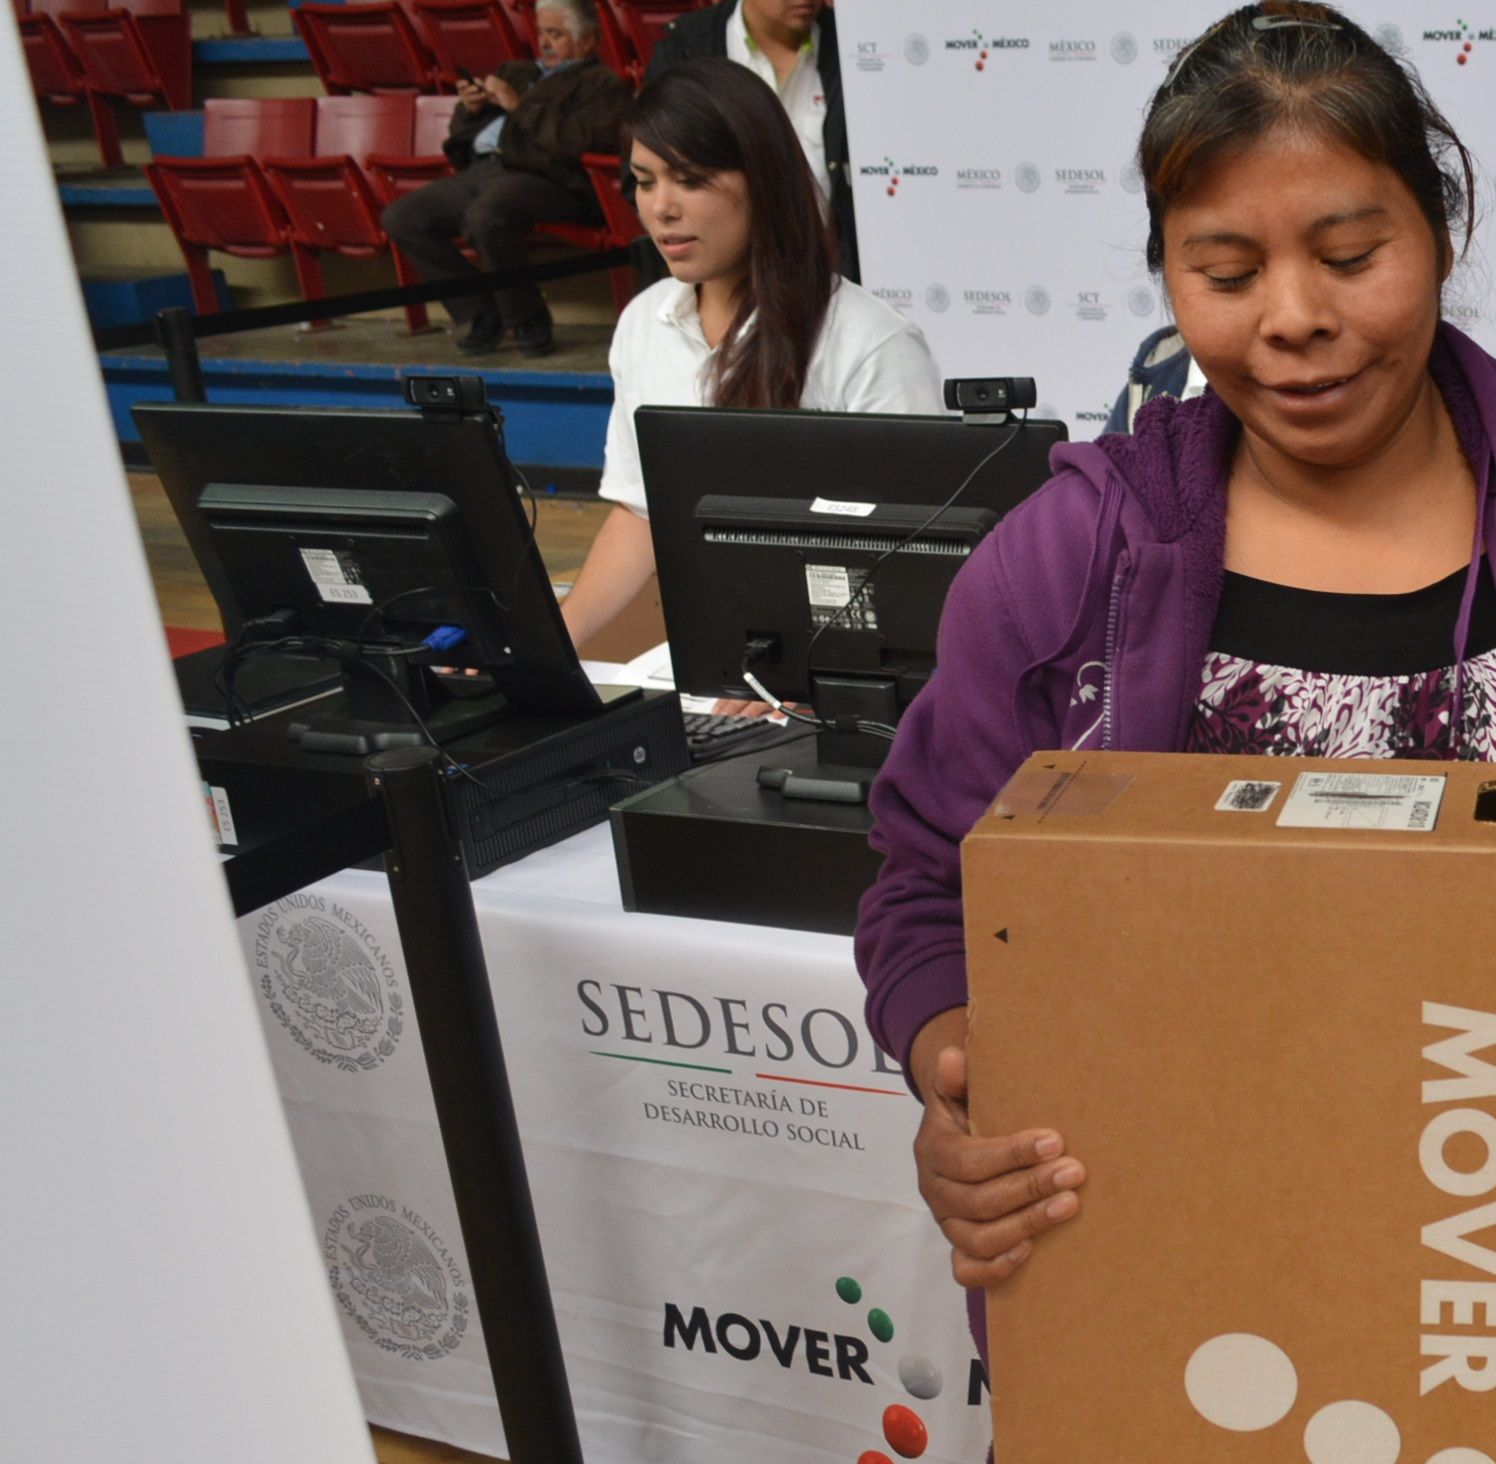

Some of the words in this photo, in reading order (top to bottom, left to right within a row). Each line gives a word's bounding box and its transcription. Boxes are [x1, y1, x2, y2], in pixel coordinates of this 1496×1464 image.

[945, 39, 978, 49] MOVER
[992, 36, 1030, 49] MÉXICO
[1423, 30, 1462, 41] MOVER
[860, 166, 889, 176] MOVER
[902, 164, 939, 176] MÉXICO
[1055, 169, 1106, 181] SEDESOL
[963, 289, 1012, 302] SEDESOL
[254, 906, 279, 969] ESTADOS
[276, 893, 326, 915] UNIDOS
[330, 903, 399, 989] MEXICANOS
[667, 1079, 793, 1114] SECRETARÍA
[799, 1097, 829, 1119] DE
[643, 1102, 779, 1139] DESARROLLO
[786, 1123, 866, 1152] SOCIAL
[325, 1205, 350, 1262] ESTADOS
[348, 1194, 398, 1214] UNIDOS
[401, 1205, 465, 1288] MEXICANOS
[663, 1302, 876, 1386] MOVER
